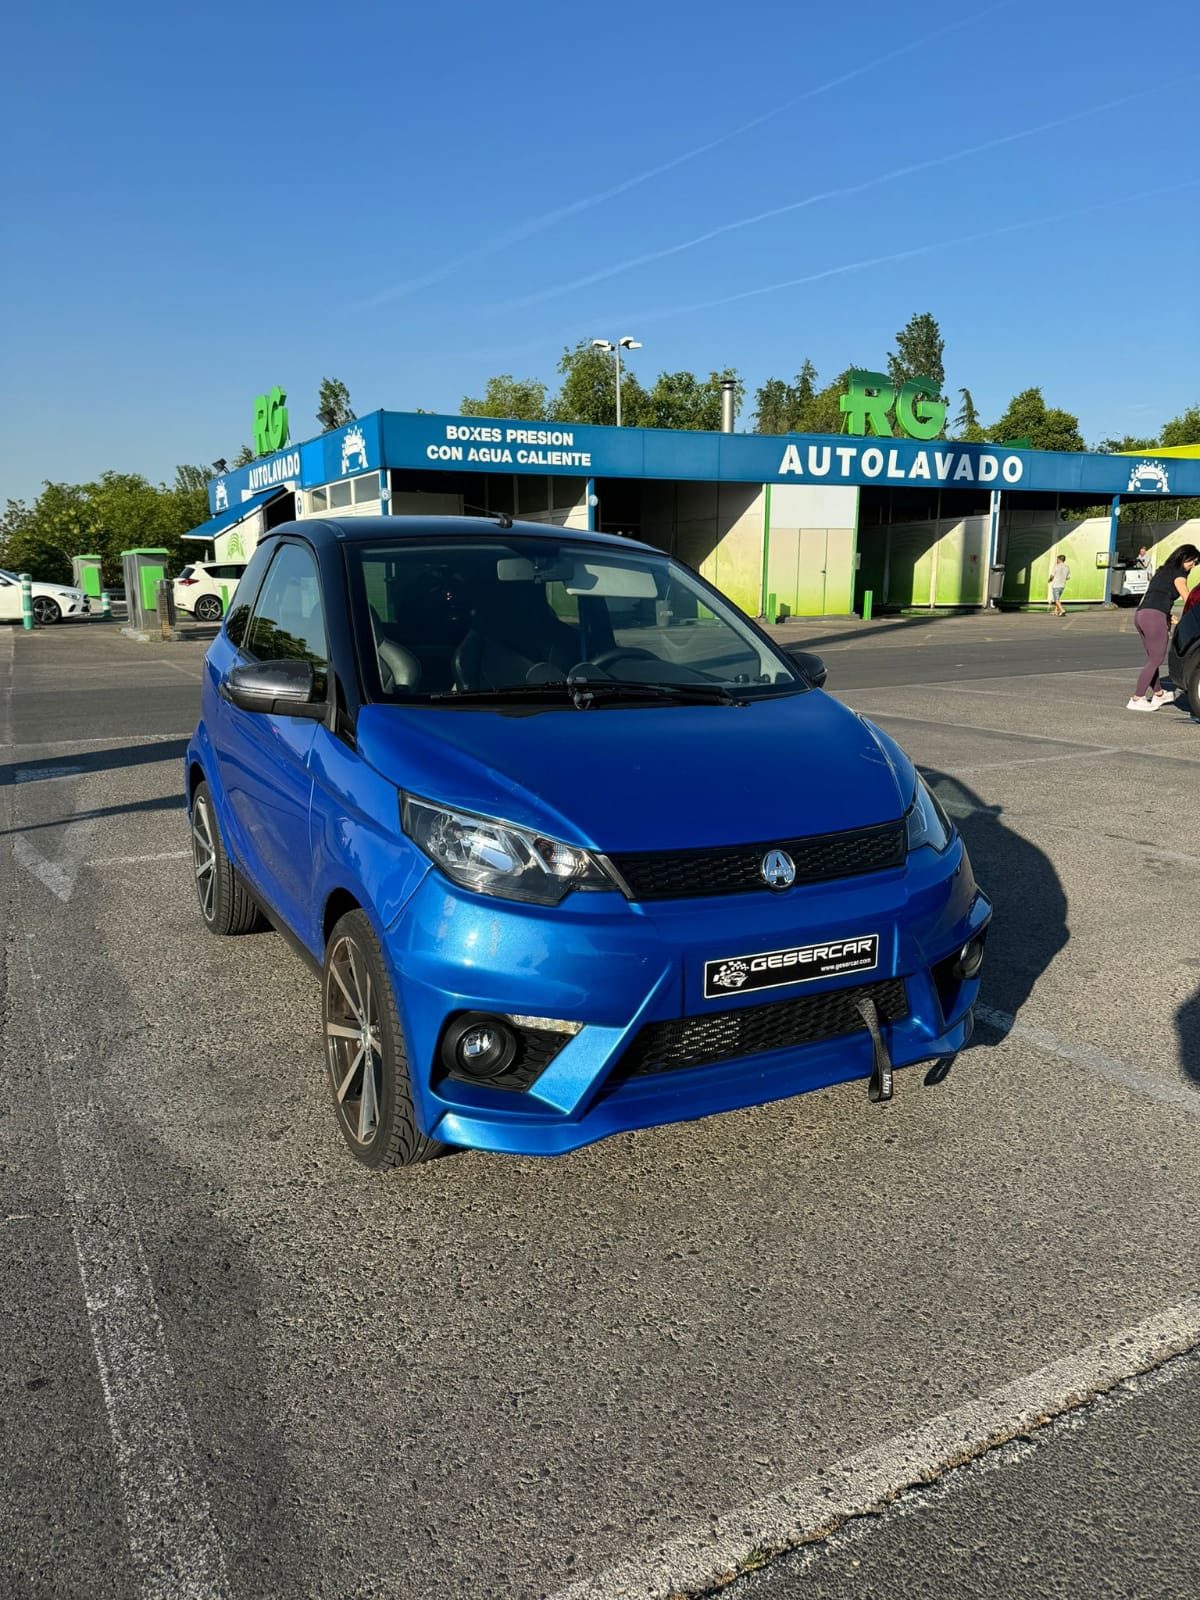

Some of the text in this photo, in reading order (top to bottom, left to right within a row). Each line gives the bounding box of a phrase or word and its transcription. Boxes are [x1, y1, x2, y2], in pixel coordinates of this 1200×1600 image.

[254, 385, 289, 457] RG
[840, 367, 946, 440] RG
[446, 425, 574, 447] BOXES PRESION
[248, 451, 301, 490] AUTOLAVADO
[426, 445, 592, 467] CON AGUA CALIENTE
[778, 444, 1024, 483] AUTOLAVADO
[750, 939, 873, 972] GESERCAR
[820, 957, 872, 973] www.gesercar.com
